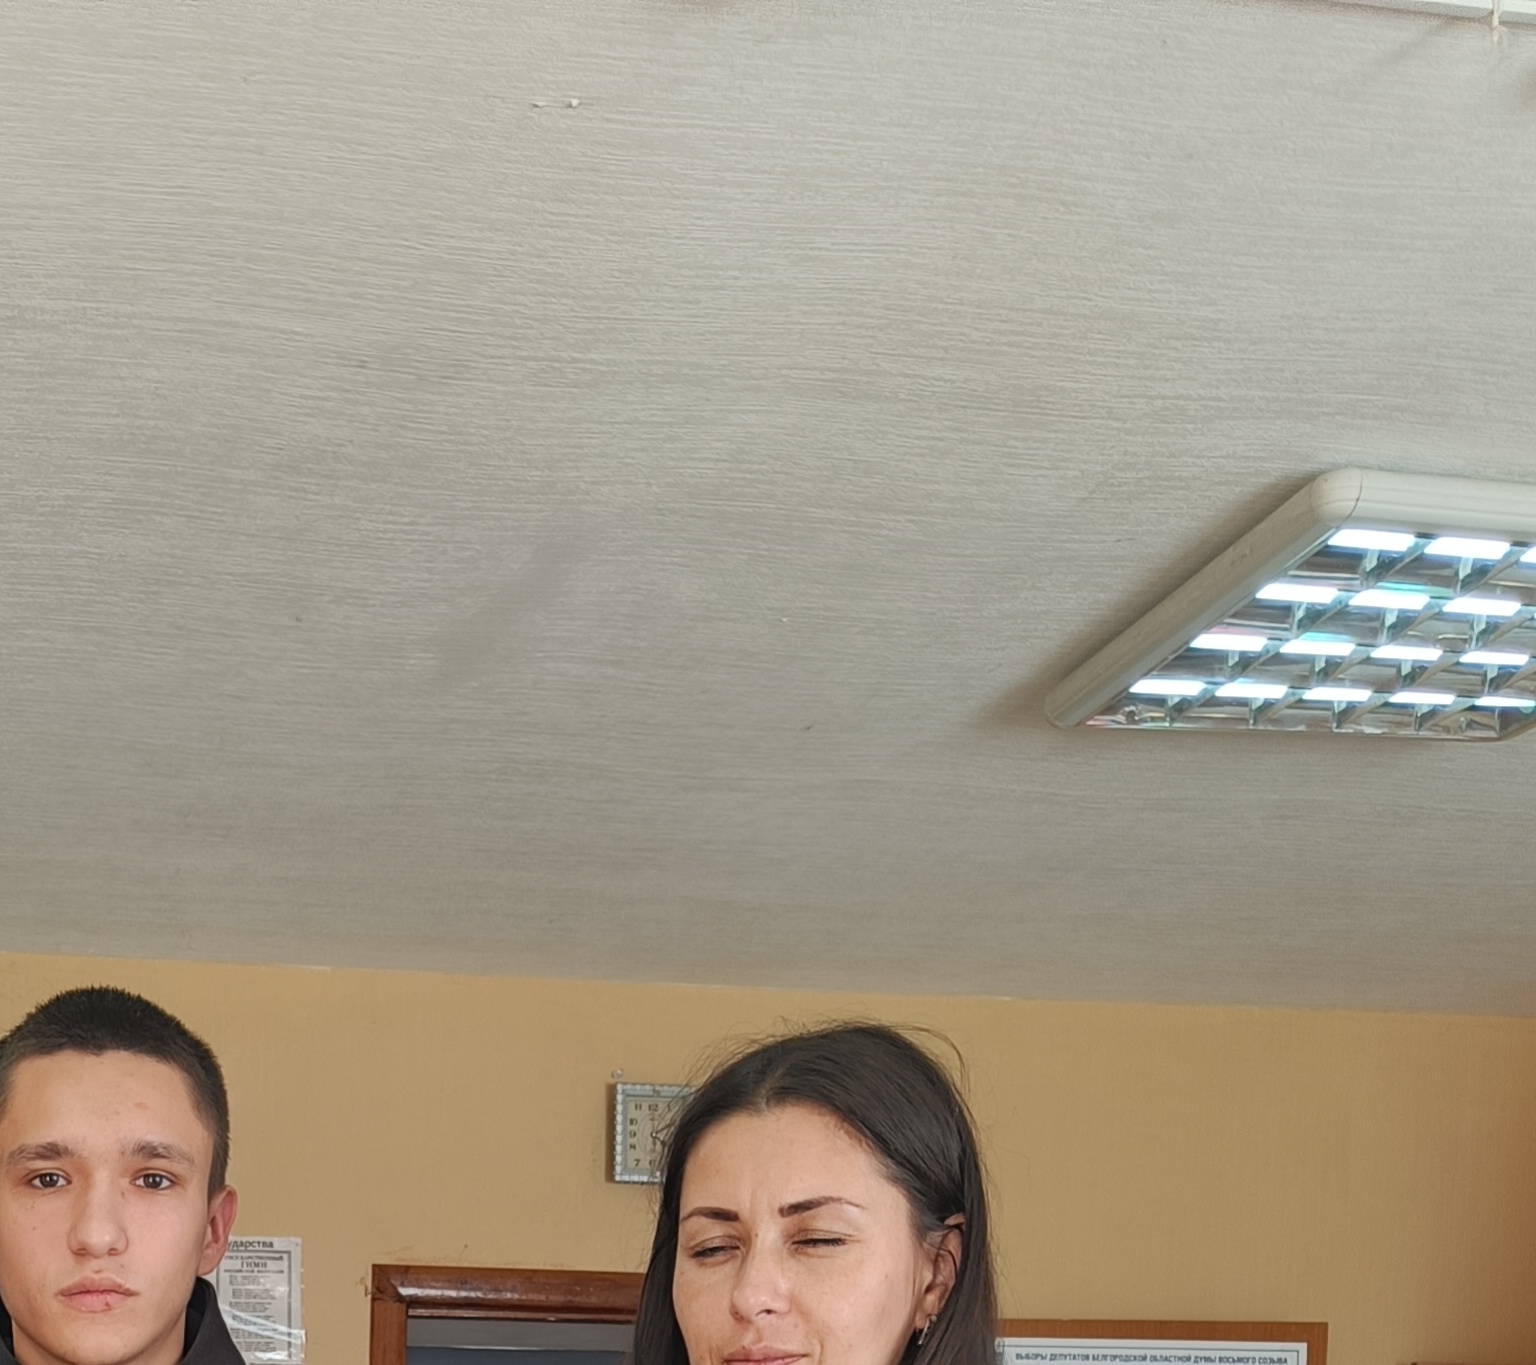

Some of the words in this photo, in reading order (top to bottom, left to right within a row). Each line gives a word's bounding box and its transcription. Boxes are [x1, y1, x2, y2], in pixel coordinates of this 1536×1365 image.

[648, 1103, 659, 1112] 12
[227, 1240, 274, 1250] ударства
[1015, 1353, 1047, 1361] ВЫБОРЫ
[1049, 1353, 1090, 1362] ДЕПУТАТОВ
[1092, 1353, 1148, 1362] БЕЛГОРОДСКОЙ
[1149, 1354, 1192, 1363] ОБЛАСТНОЙ
[1193, 1355, 1217, 1364] ДУМЫ
[1218, 1356, 1256, 1364] ВОСЬМОГО
[1258, 1357, 1288, 1365] СОЗЫВА
